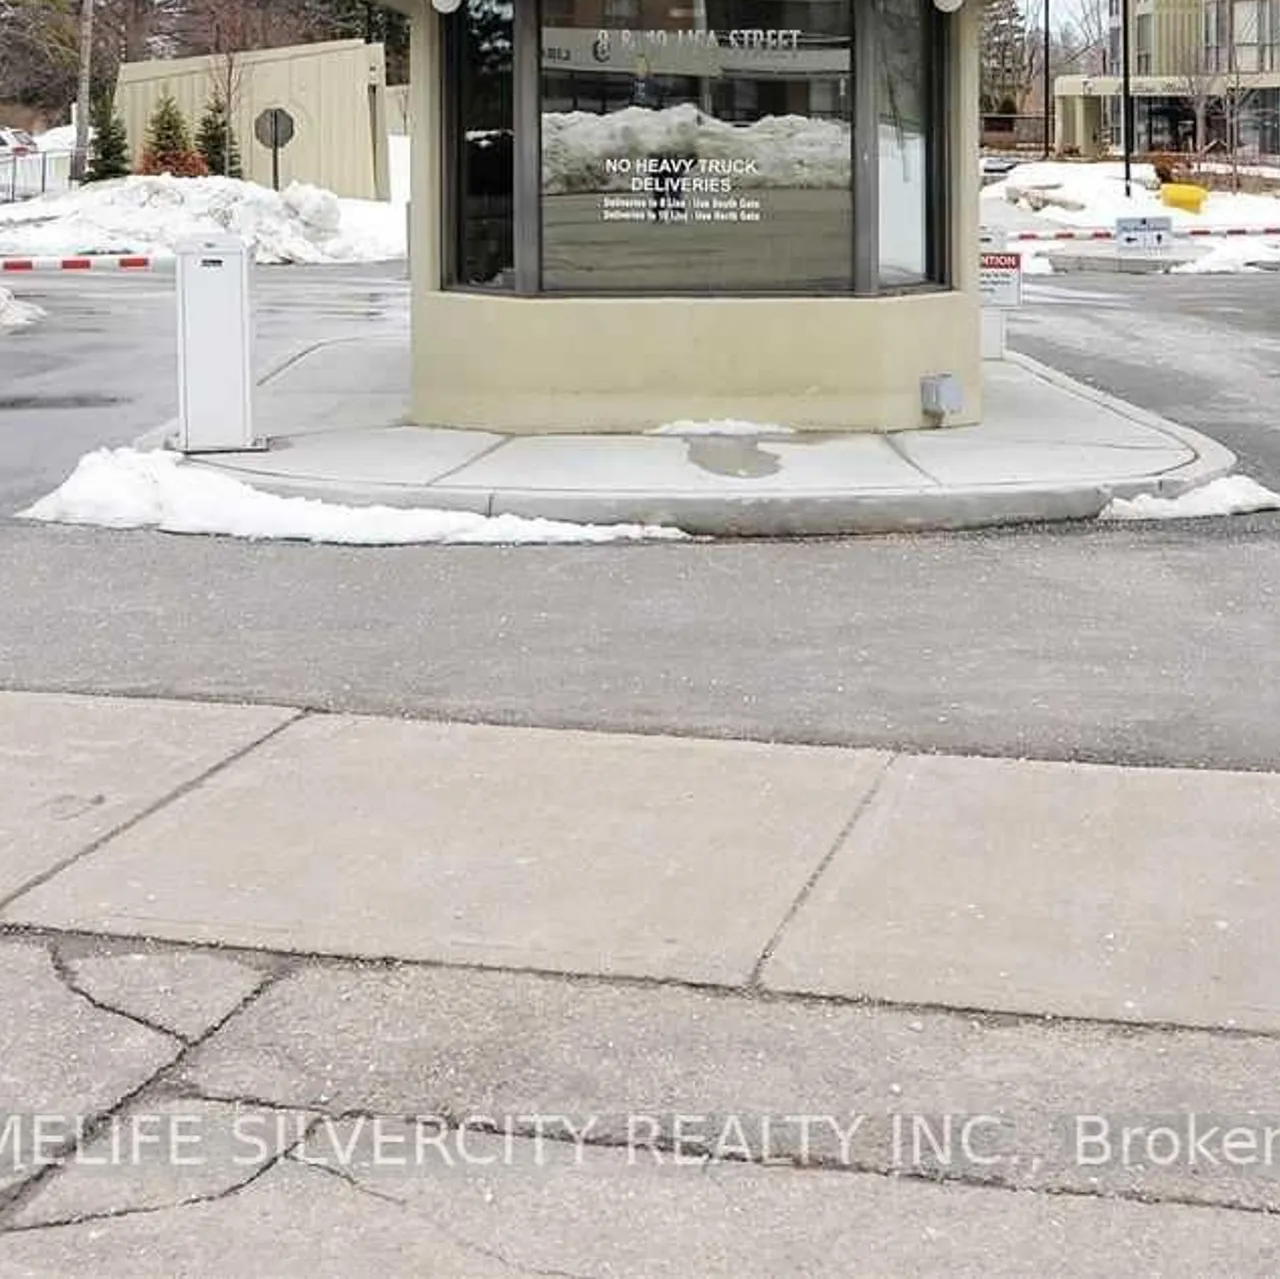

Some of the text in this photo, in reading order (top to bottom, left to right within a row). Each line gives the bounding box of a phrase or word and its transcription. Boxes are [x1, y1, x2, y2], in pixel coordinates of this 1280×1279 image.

[728, 29, 803, 48] STREET
[605, 158, 758, 173] NO HEAVY TRUCK
[631, 177, 732, 193] DELIVERIES
